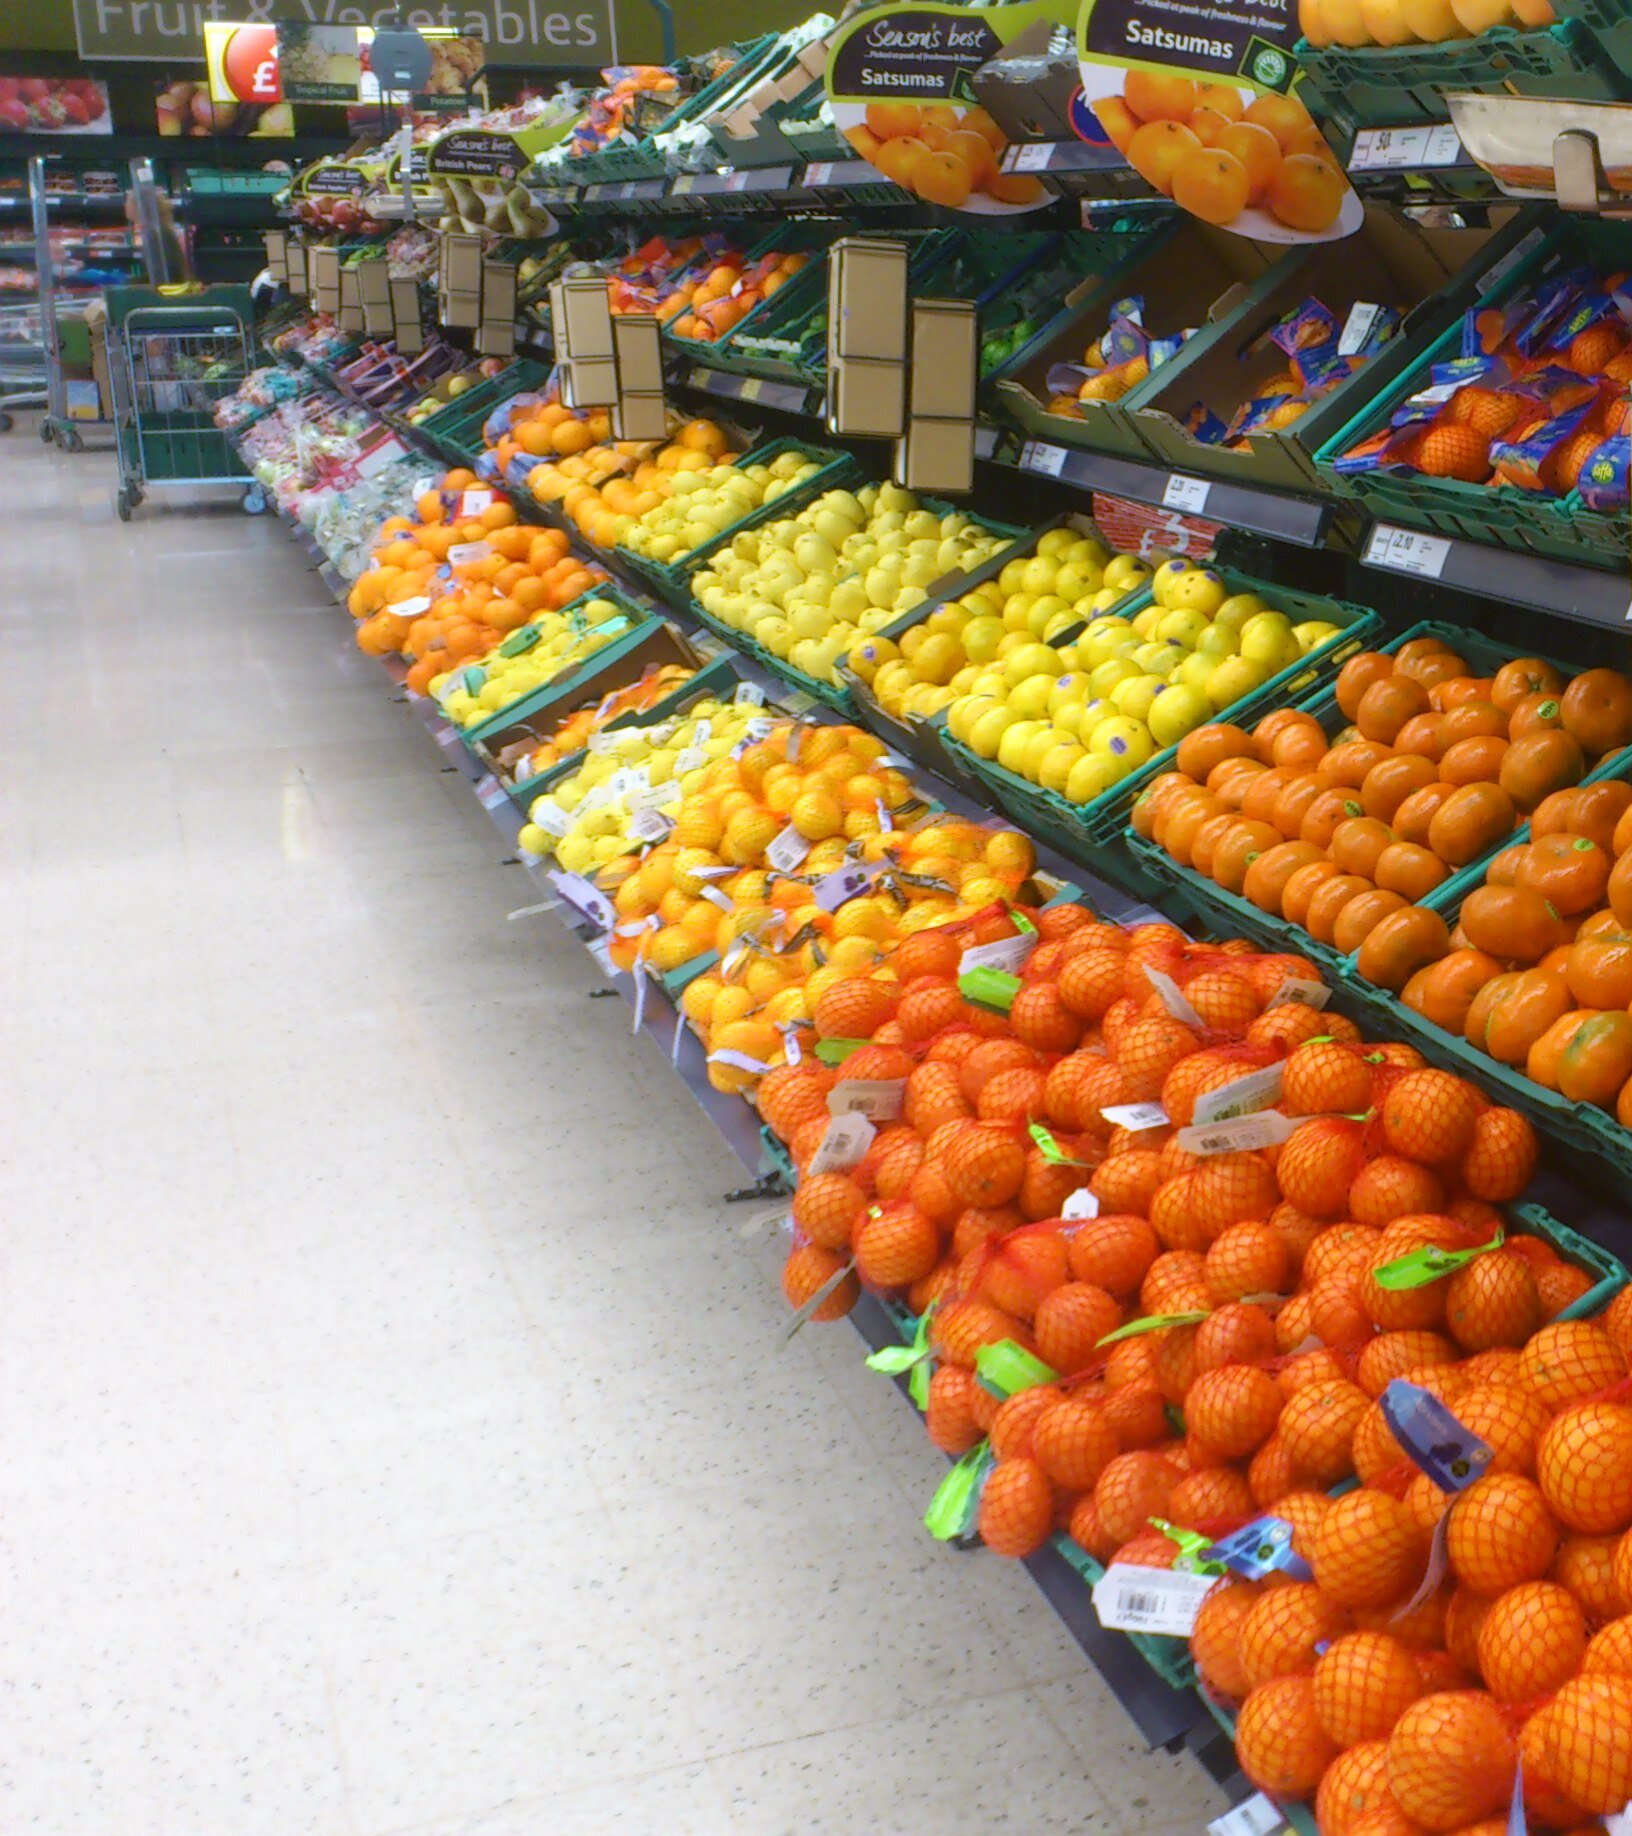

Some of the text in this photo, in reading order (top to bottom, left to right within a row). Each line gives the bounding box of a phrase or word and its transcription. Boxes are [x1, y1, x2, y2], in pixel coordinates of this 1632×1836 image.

[866, 20, 987, 49] Season's best
[1125, 19, 1234, 60] Satsumas
[861, 67, 945, 88] Satsumas
